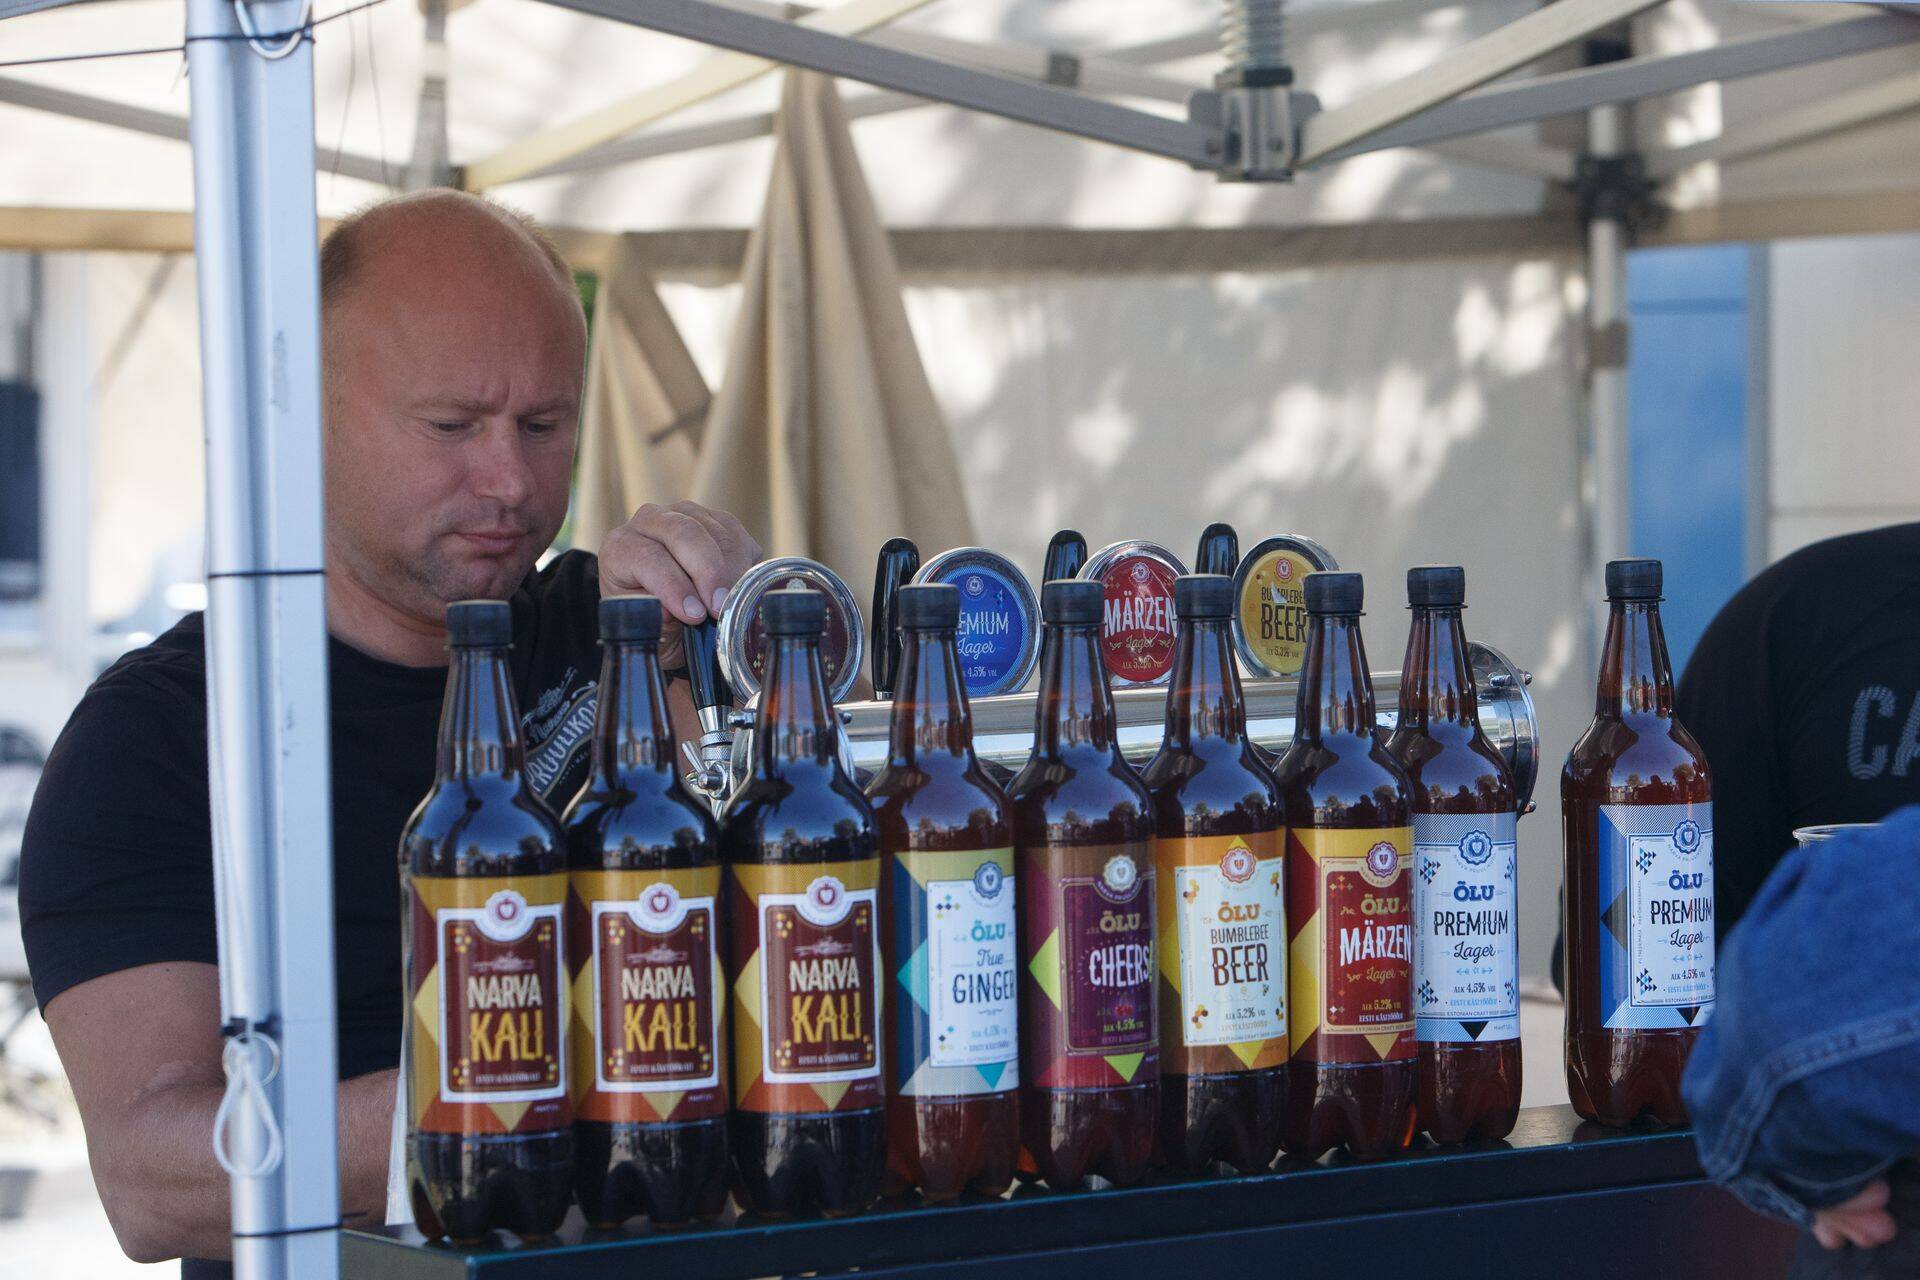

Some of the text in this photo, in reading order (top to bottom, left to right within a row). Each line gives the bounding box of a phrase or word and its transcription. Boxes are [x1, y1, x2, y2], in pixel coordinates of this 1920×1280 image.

[955, 610, 1009, 636] EMIUM
[1104, 590, 1178, 638] MÄRZEN
[1261, 603, 1307, 643] BEER
[957, 637, 996, 660] Lager
[1125, 635, 1155, 654] Lager
[1453, 879, 1496, 903] ÕLU
[1668, 869, 1703, 890] ÕLU
[1433, 909, 1509, 937] PREMIUM
[1651, 899, 1713, 925] PREMIUM
[1210, 923, 1269, 945] BUMBLEBEE
[1339, 920, 1412, 967] MÄRZEN
[1670, 929, 1705, 950] Lager
[976, 948, 1005, 967] True
[1211, 943, 1270, 987] BEER
[1453, 940, 1497, 964] Lager
[621, 965, 696, 1000] NARVA
[789, 956, 861, 992] NARVA
[1366, 965, 1396, 985] Lager
[467, 974, 543, 1010] NARVA
[623, 1000, 697, 1053] KALI
[791, 991, 862, 1044] KALI
[469, 1009, 544, 1062] KALI
